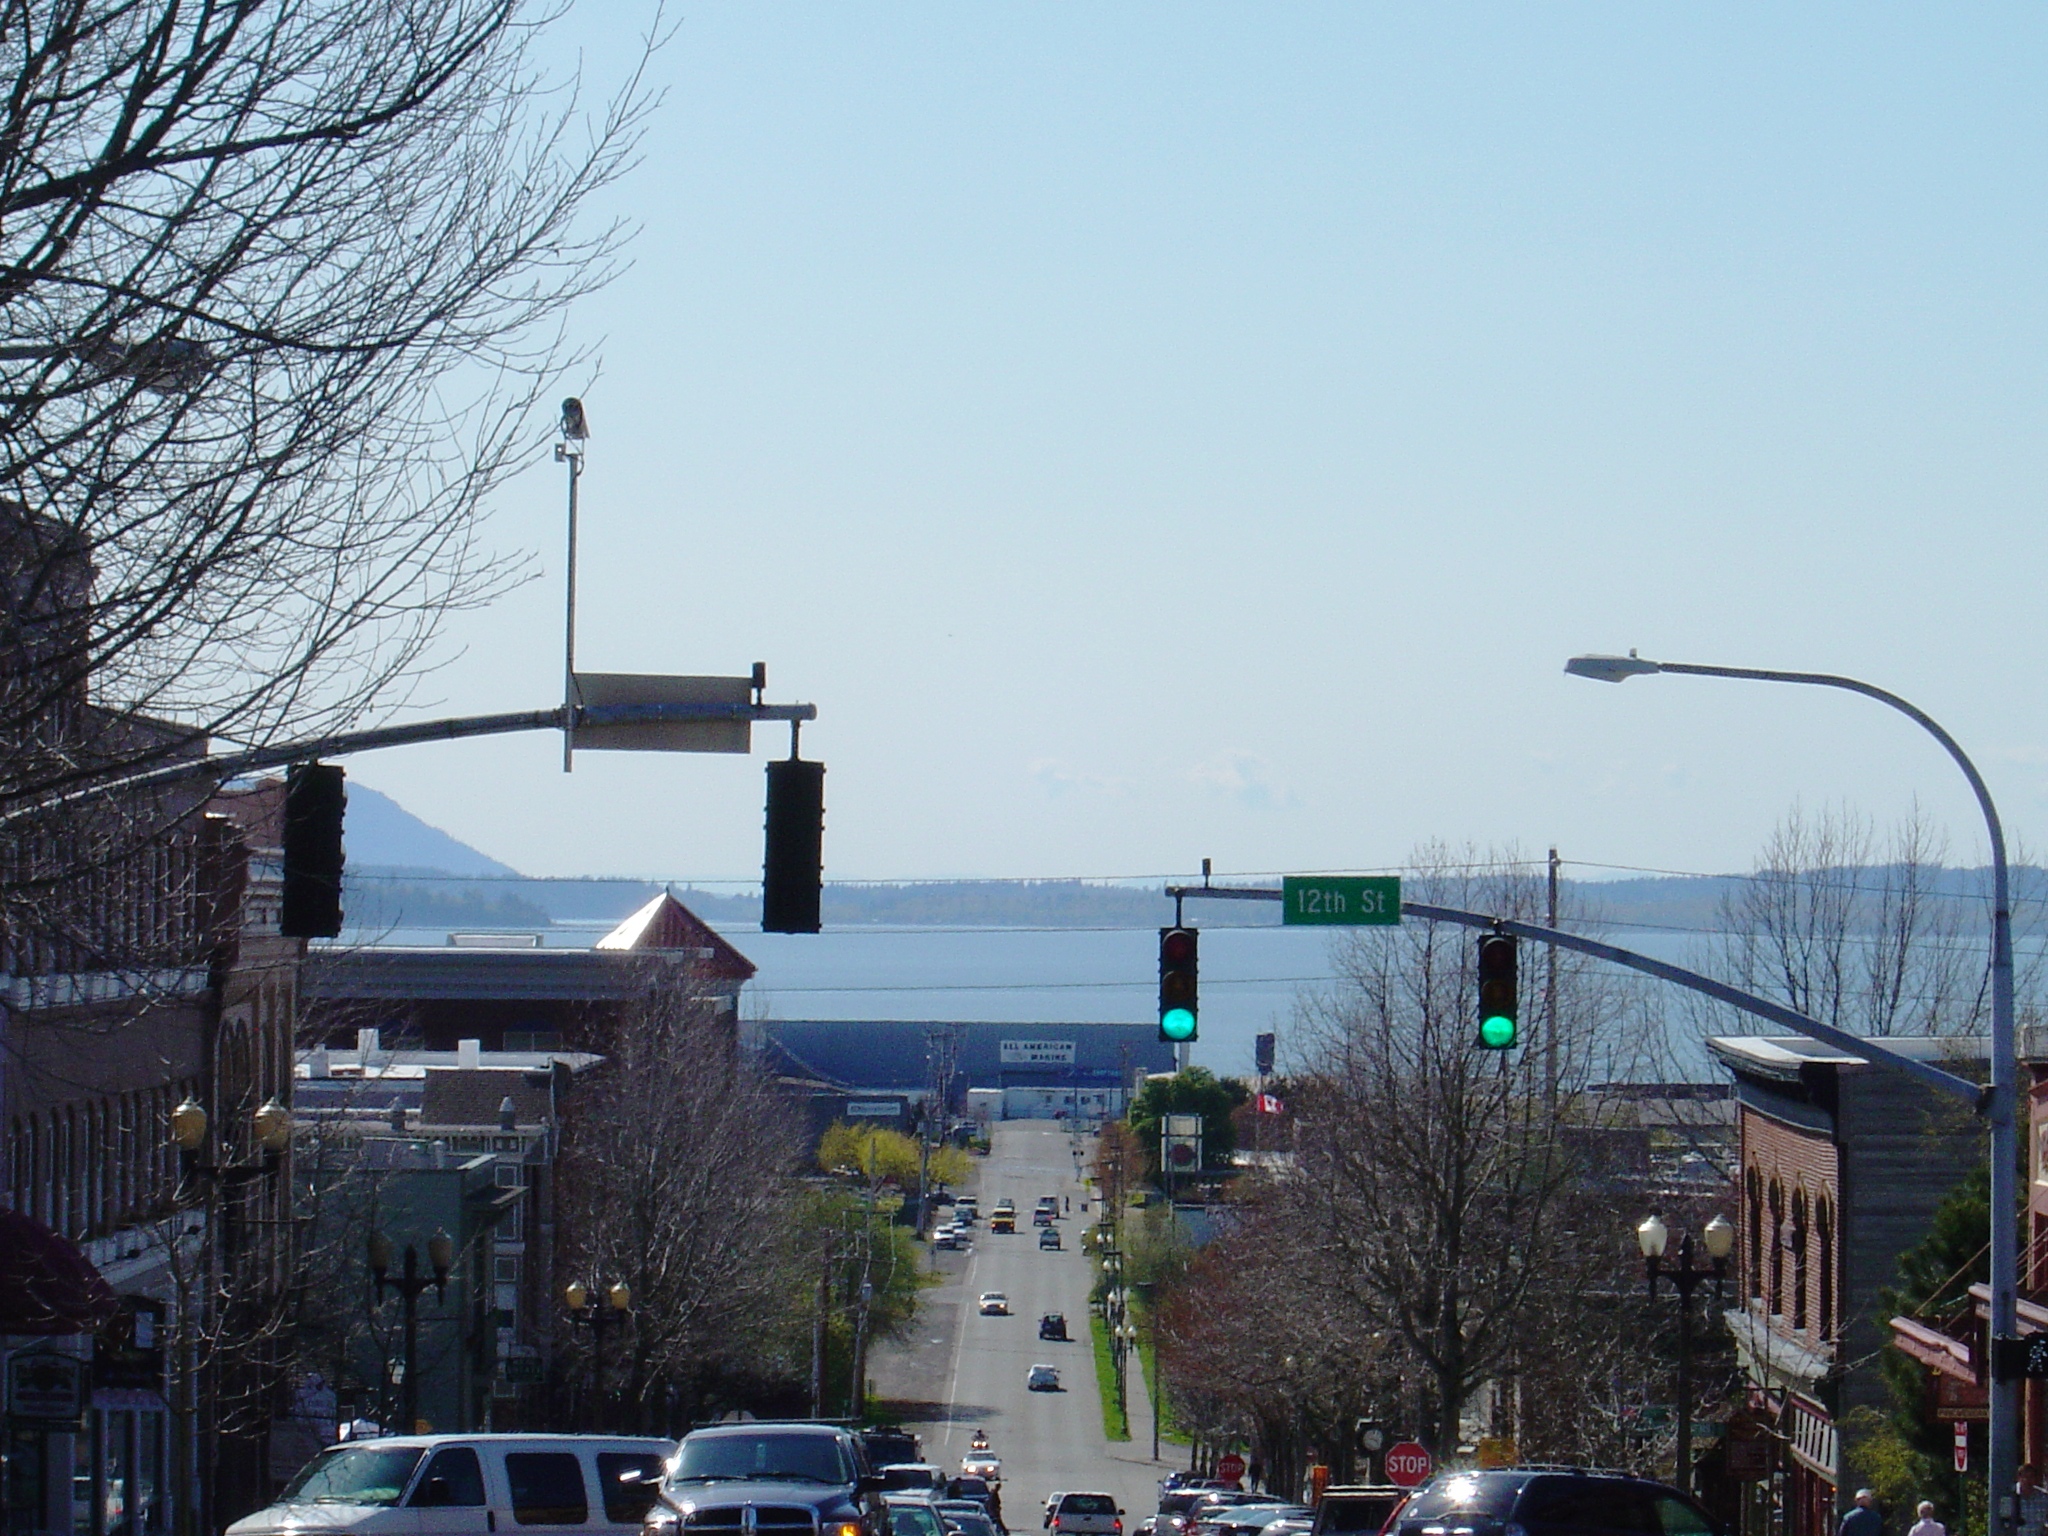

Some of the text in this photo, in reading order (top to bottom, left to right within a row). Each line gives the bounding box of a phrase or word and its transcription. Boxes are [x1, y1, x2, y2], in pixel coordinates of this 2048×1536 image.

[1298, 888, 1386, 913] 12th St
[1023, 1042, 1073, 1051] AMERICAN
[1218, 1462, 1244, 1473] STOP
[1388, 1455, 1427, 1474] STOP
